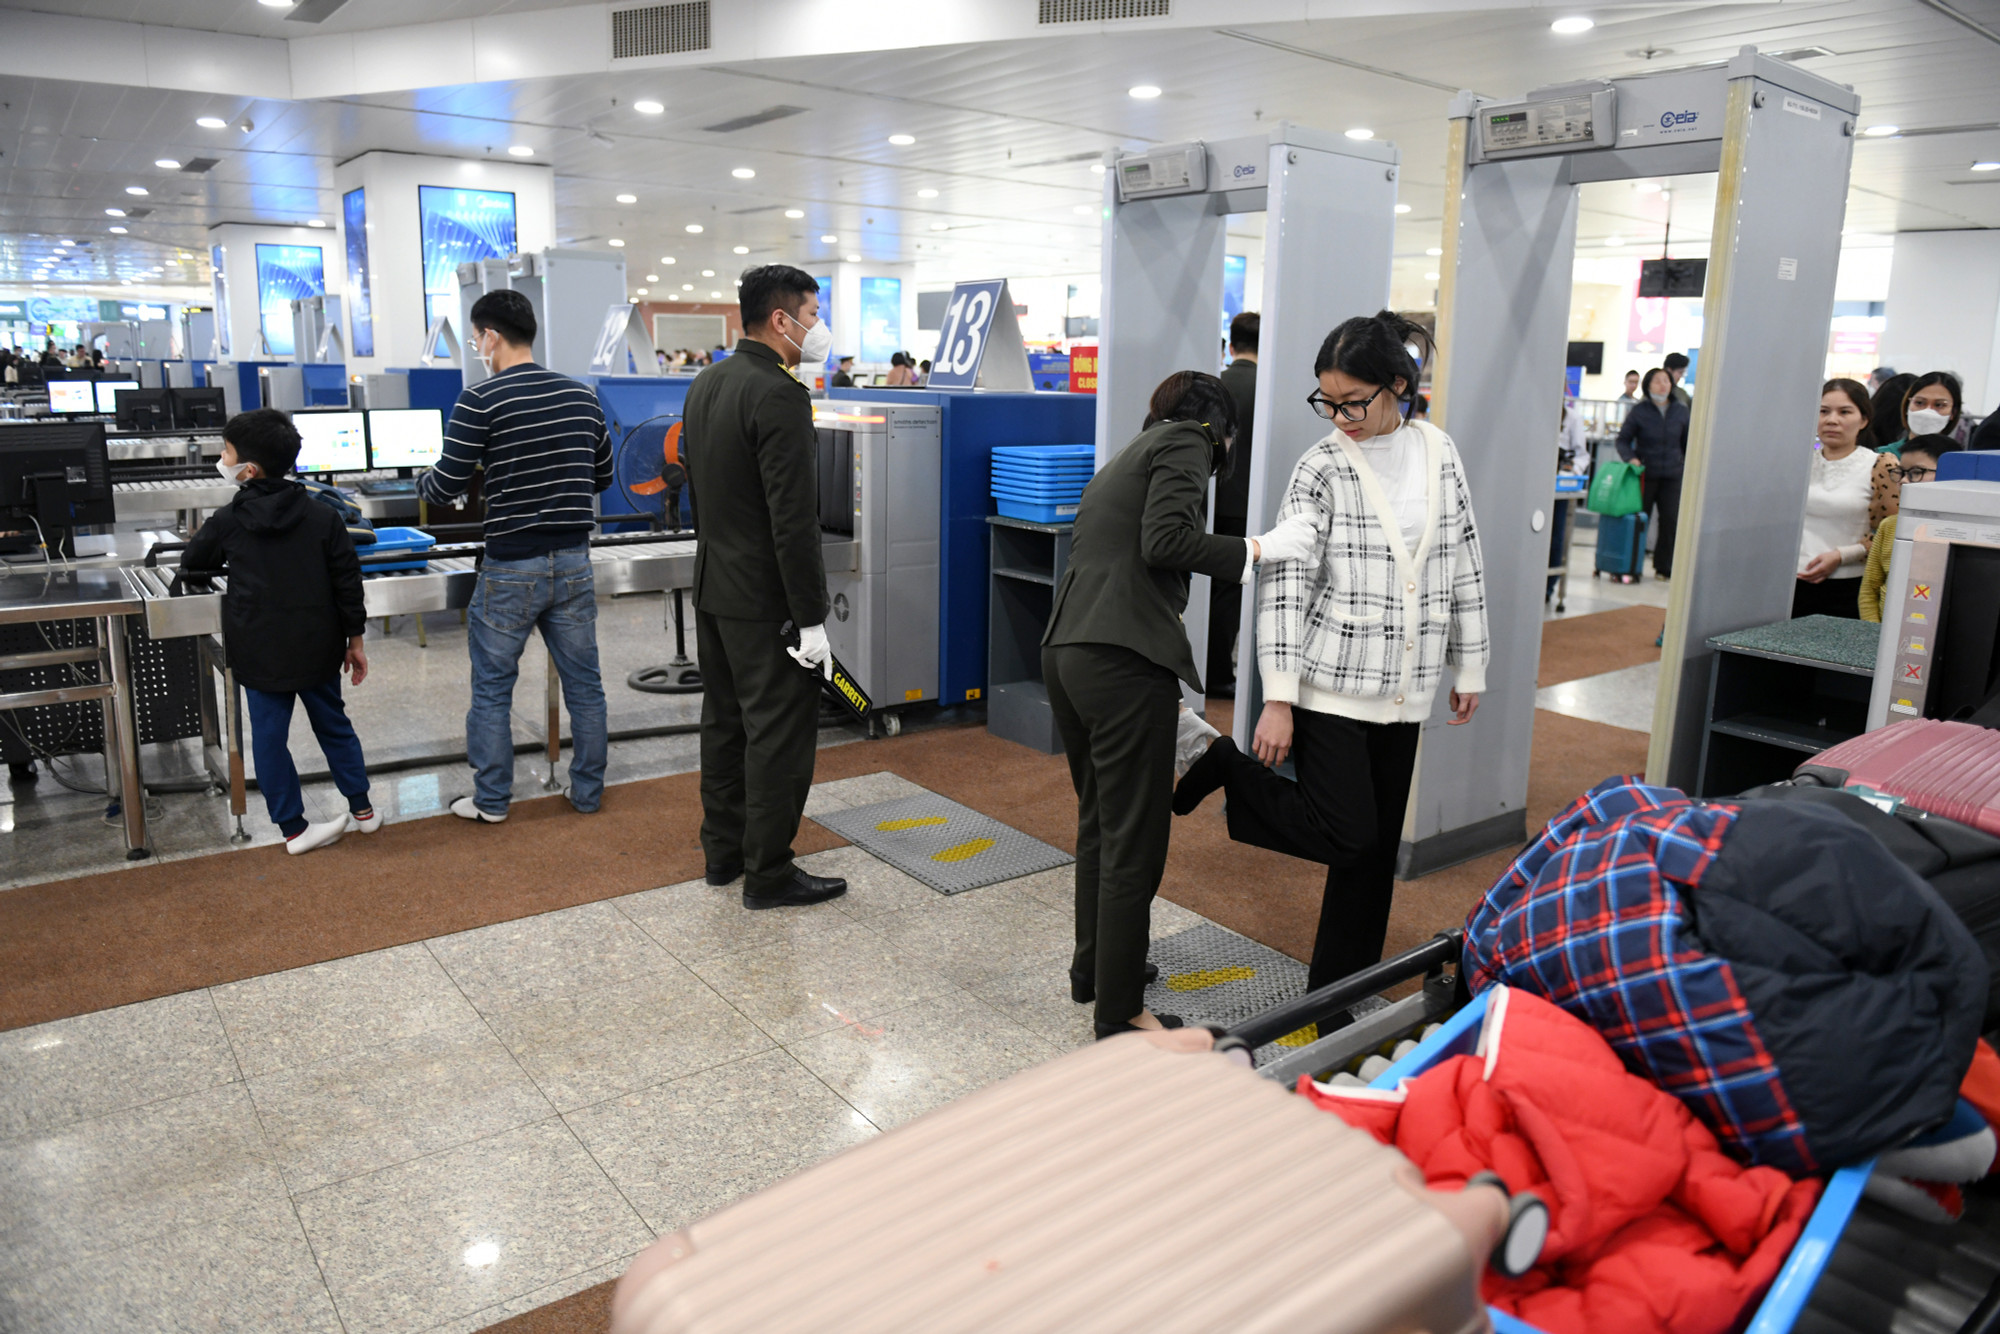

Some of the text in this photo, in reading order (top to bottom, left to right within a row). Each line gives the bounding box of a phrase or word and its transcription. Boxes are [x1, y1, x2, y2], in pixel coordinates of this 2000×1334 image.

[592, 311, 628, 366] 12
[934, 290, 992, 376] 13
[834, 672, 867, 712] GARRETT
